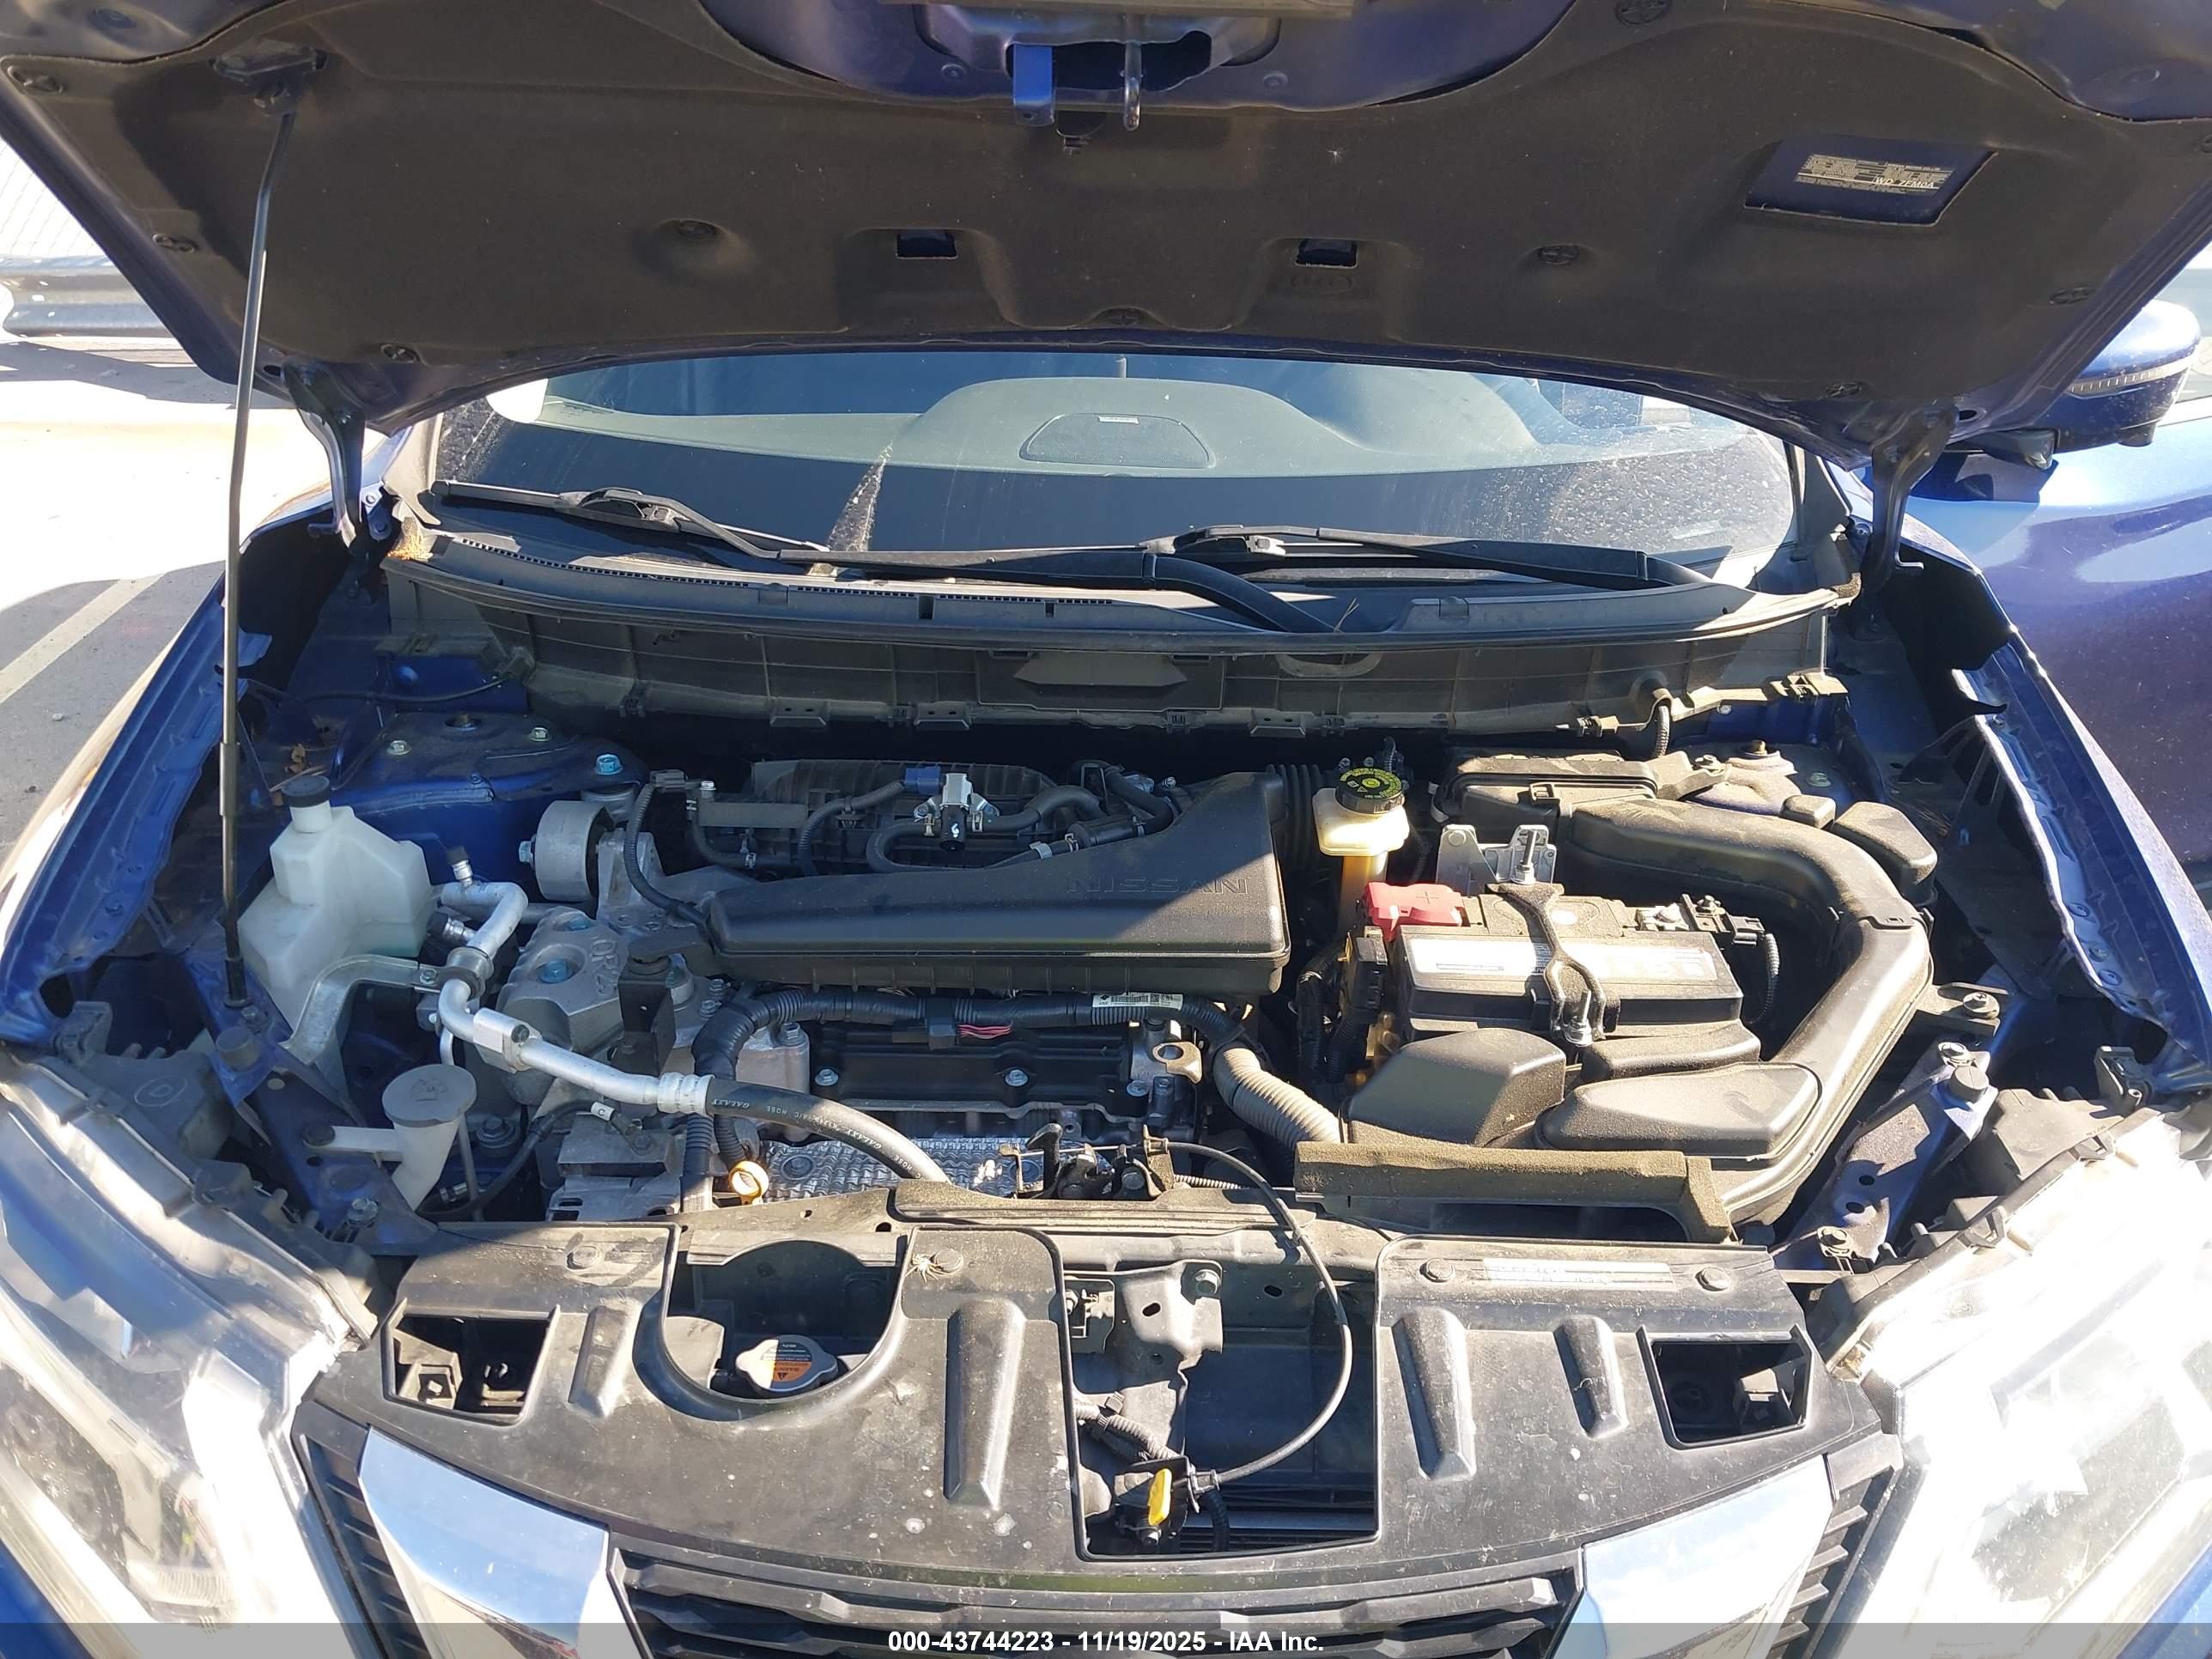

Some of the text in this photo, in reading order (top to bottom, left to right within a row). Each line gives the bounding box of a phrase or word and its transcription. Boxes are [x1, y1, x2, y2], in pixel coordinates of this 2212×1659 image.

[1067, 878, 1249, 894] NISSAN
[711, 1098, 750, 1109] GALAXY
[766, 1104, 787, 1115] HOSE
[894, 1154, 913, 1171] HOSE
